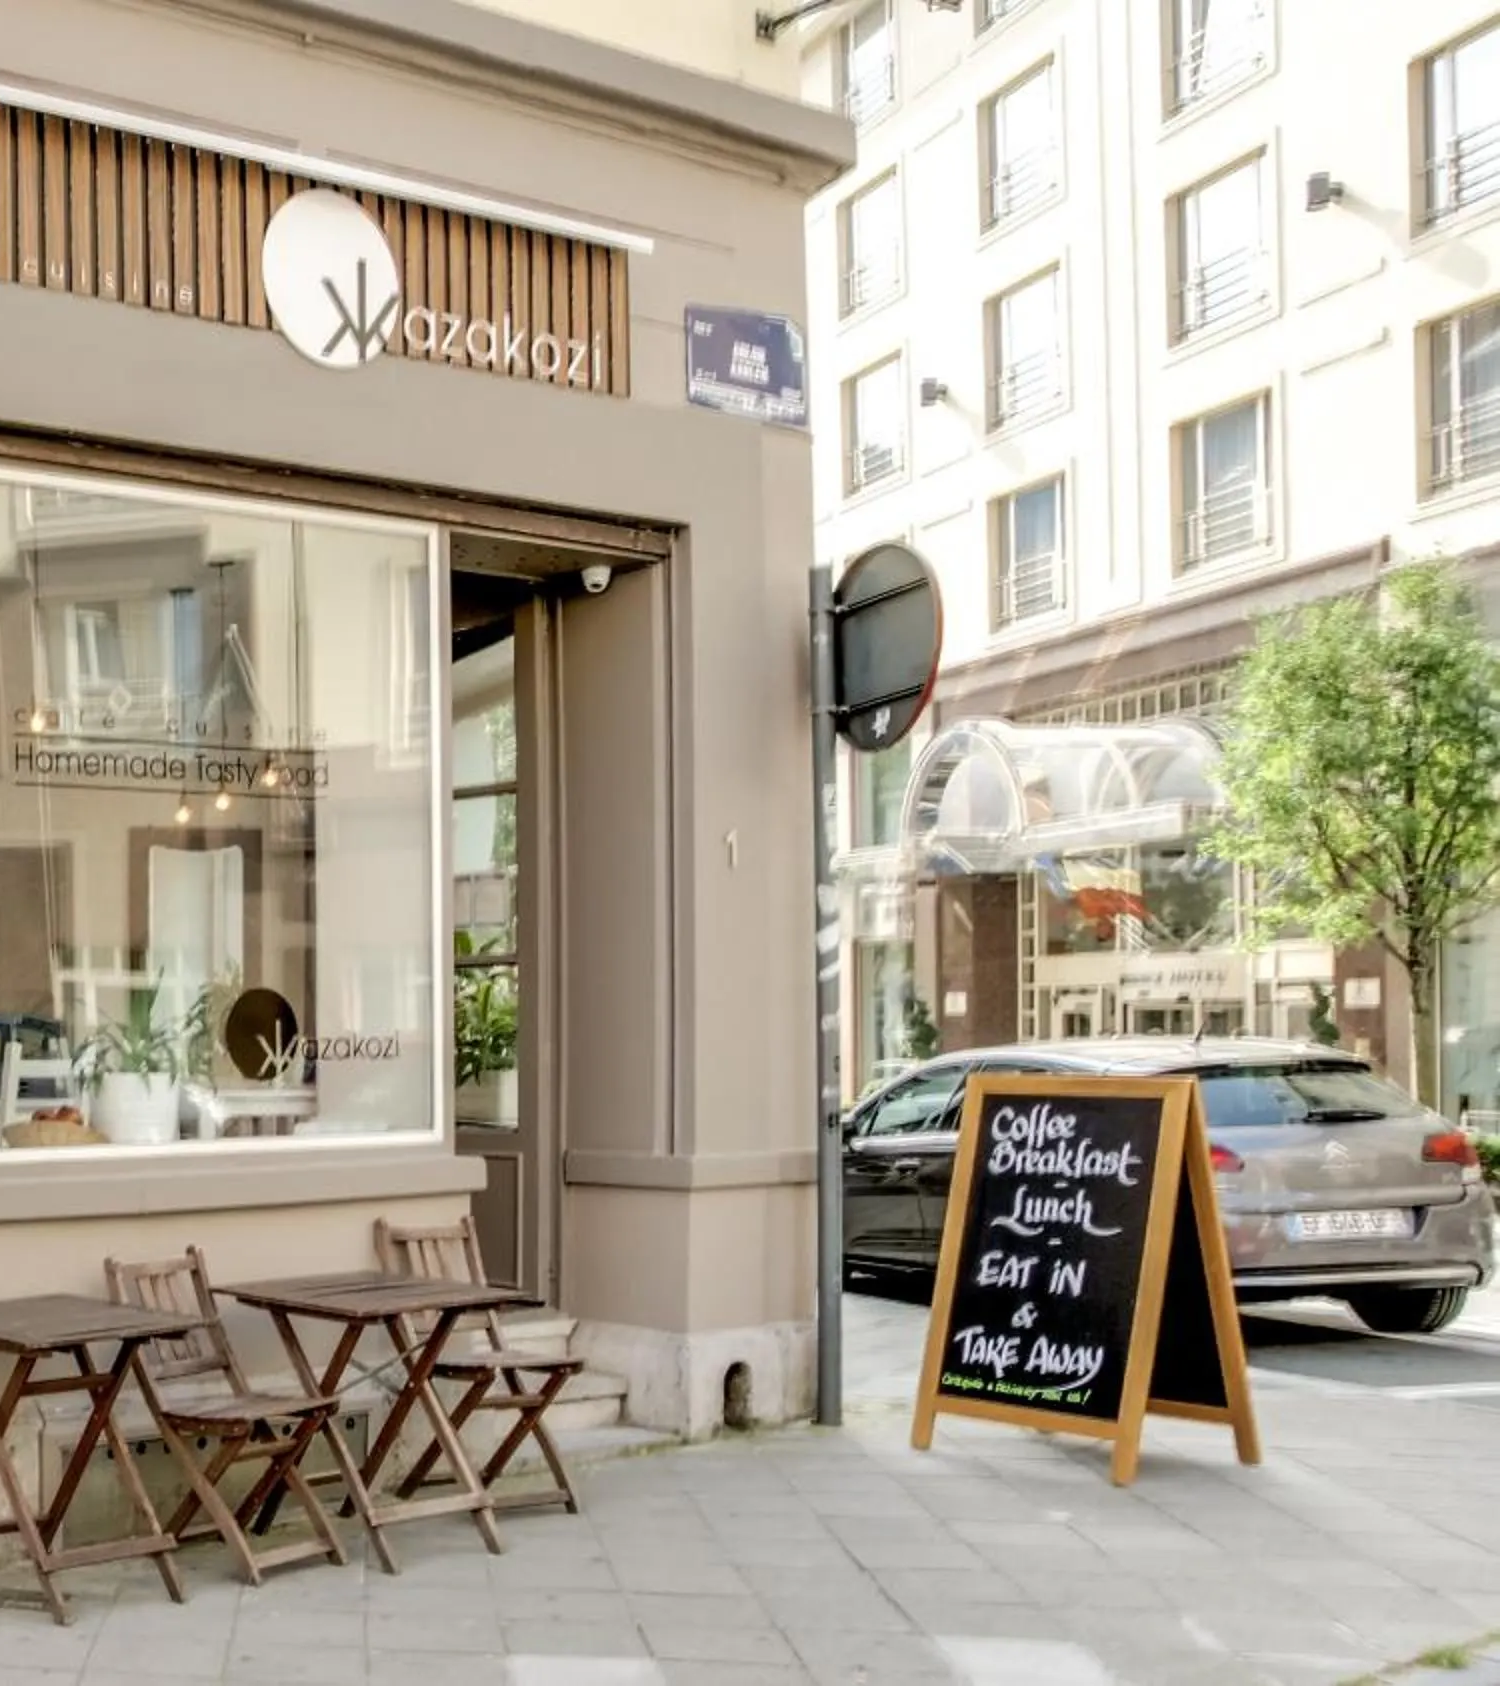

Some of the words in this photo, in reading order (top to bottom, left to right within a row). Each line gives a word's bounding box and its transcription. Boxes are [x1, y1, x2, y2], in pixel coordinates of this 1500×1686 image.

[23, 257, 194, 304] cuisine
[14, 742, 187, 781] Homemade
[195, 751, 259, 790] Tasty
[263, 755, 330, 788] ood
[991, 1103, 1078, 1149] Coffee
[987, 1138, 1142, 1187] Breakfast
[990, 1184, 1124, 1237] Lunch
[976, 1250, 1041, 1289] EAT
[1011, 1302, 1039, 1330] &
